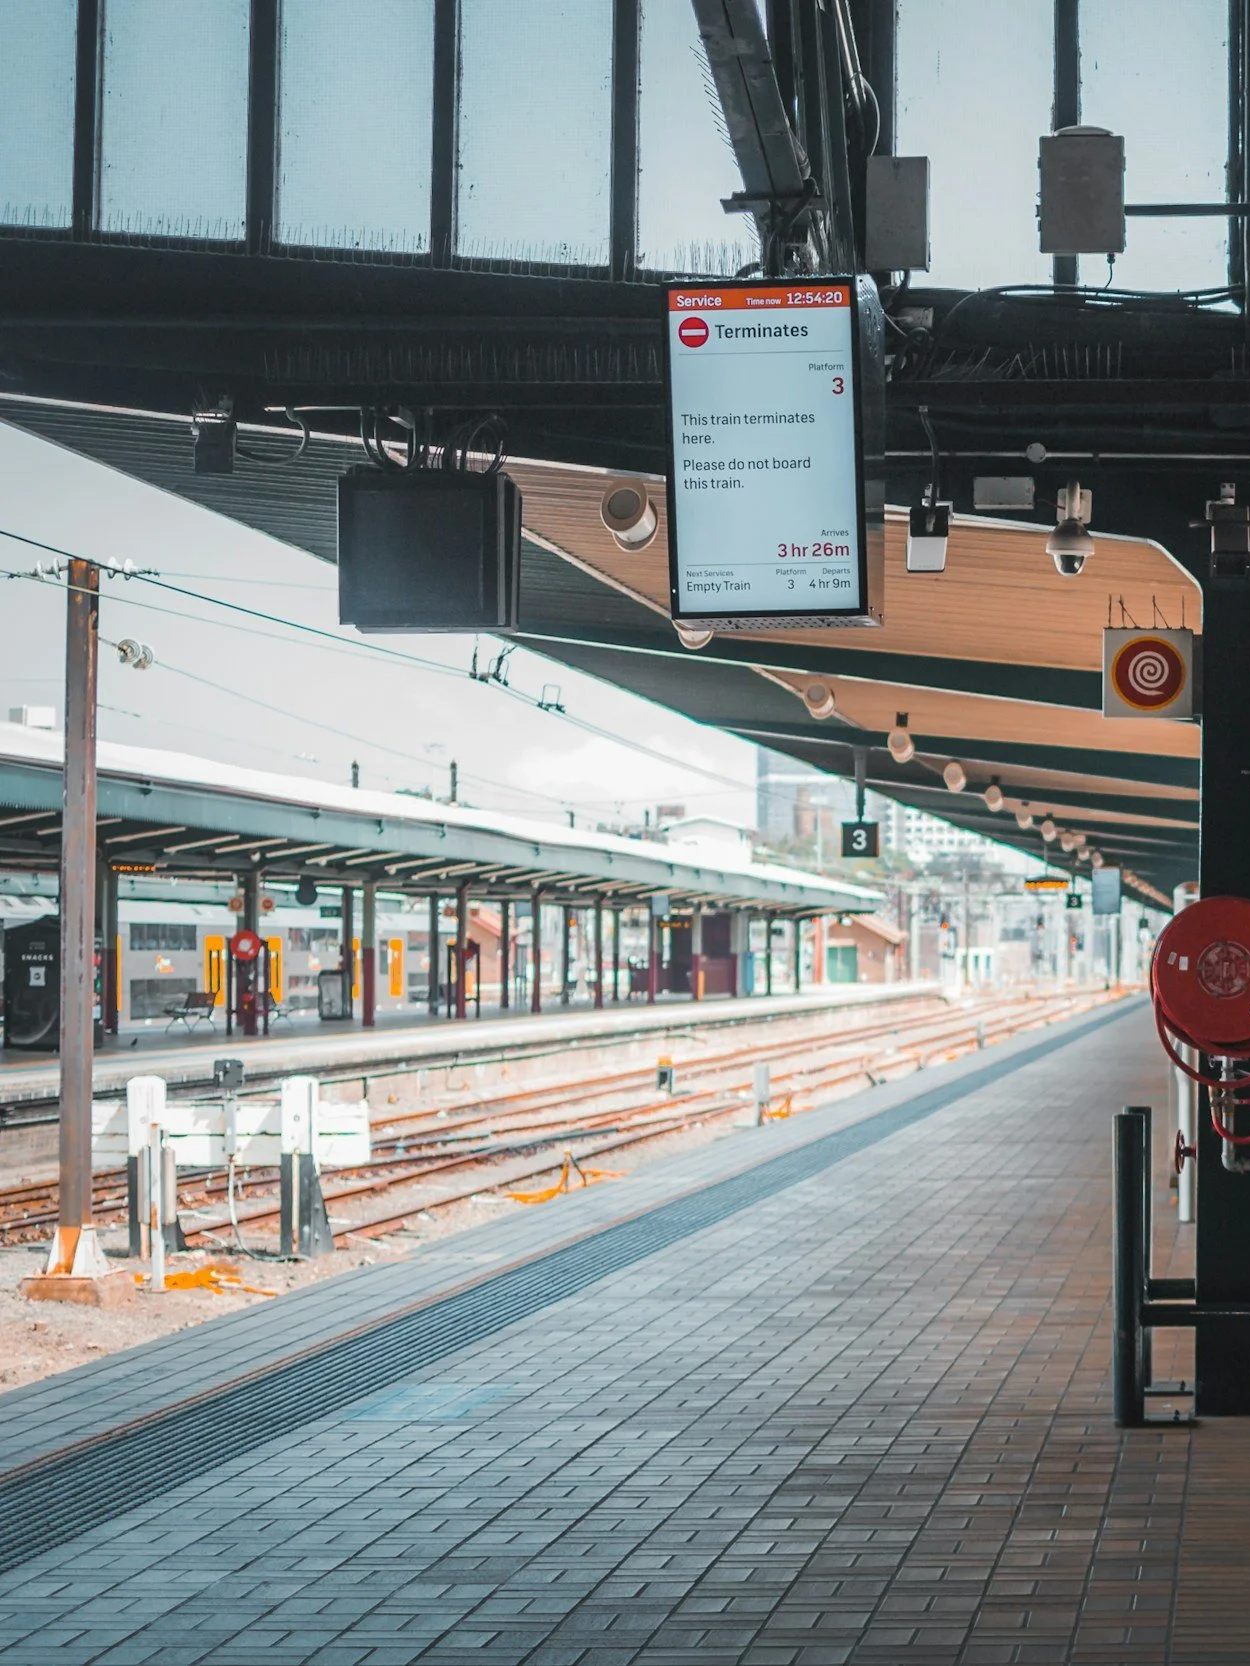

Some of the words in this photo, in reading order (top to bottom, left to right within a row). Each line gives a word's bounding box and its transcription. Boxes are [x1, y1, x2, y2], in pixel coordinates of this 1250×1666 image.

[676, 295, 722, 308] Service
[746, 297, 764, 306] Time
[787, 292, 842, 305] 12:54:20
[715, 324, 808, 339] Terminates
[809, 362, 844, 372] Platform
[832, 377, 844, 395] 3
[682, 413, 708, 425] This
[710, 413, 741, 425] train
[744, 411, 815, 424] terminates
[682, 432, 715, 445] here.
[683, 459, 725, 471] Please
[728, 458, 745, 471] do
[747, 459, 770, 470] not
[772, 457, 811, 469] board
[684, 477, 708, 489] this
[711, 477, 744, 489] train.
[778, 544, 787, 557] 3
[791, 543, 808, 557] hr
[812, 543, 850, 556] 26m
[776, 568, 807, 576] Platform
[822, 567, 851, 577] Departs
[687, 581, 721, 594] Empty
[723, 580, 750, 590] Train
[788, 579, 795, 590] 3
[809, 579, 816, 589] 4
[818, 579, 830, 589] hr
[832, 578, 851, 588] 9m
[852, 829, 867, 851] 3
